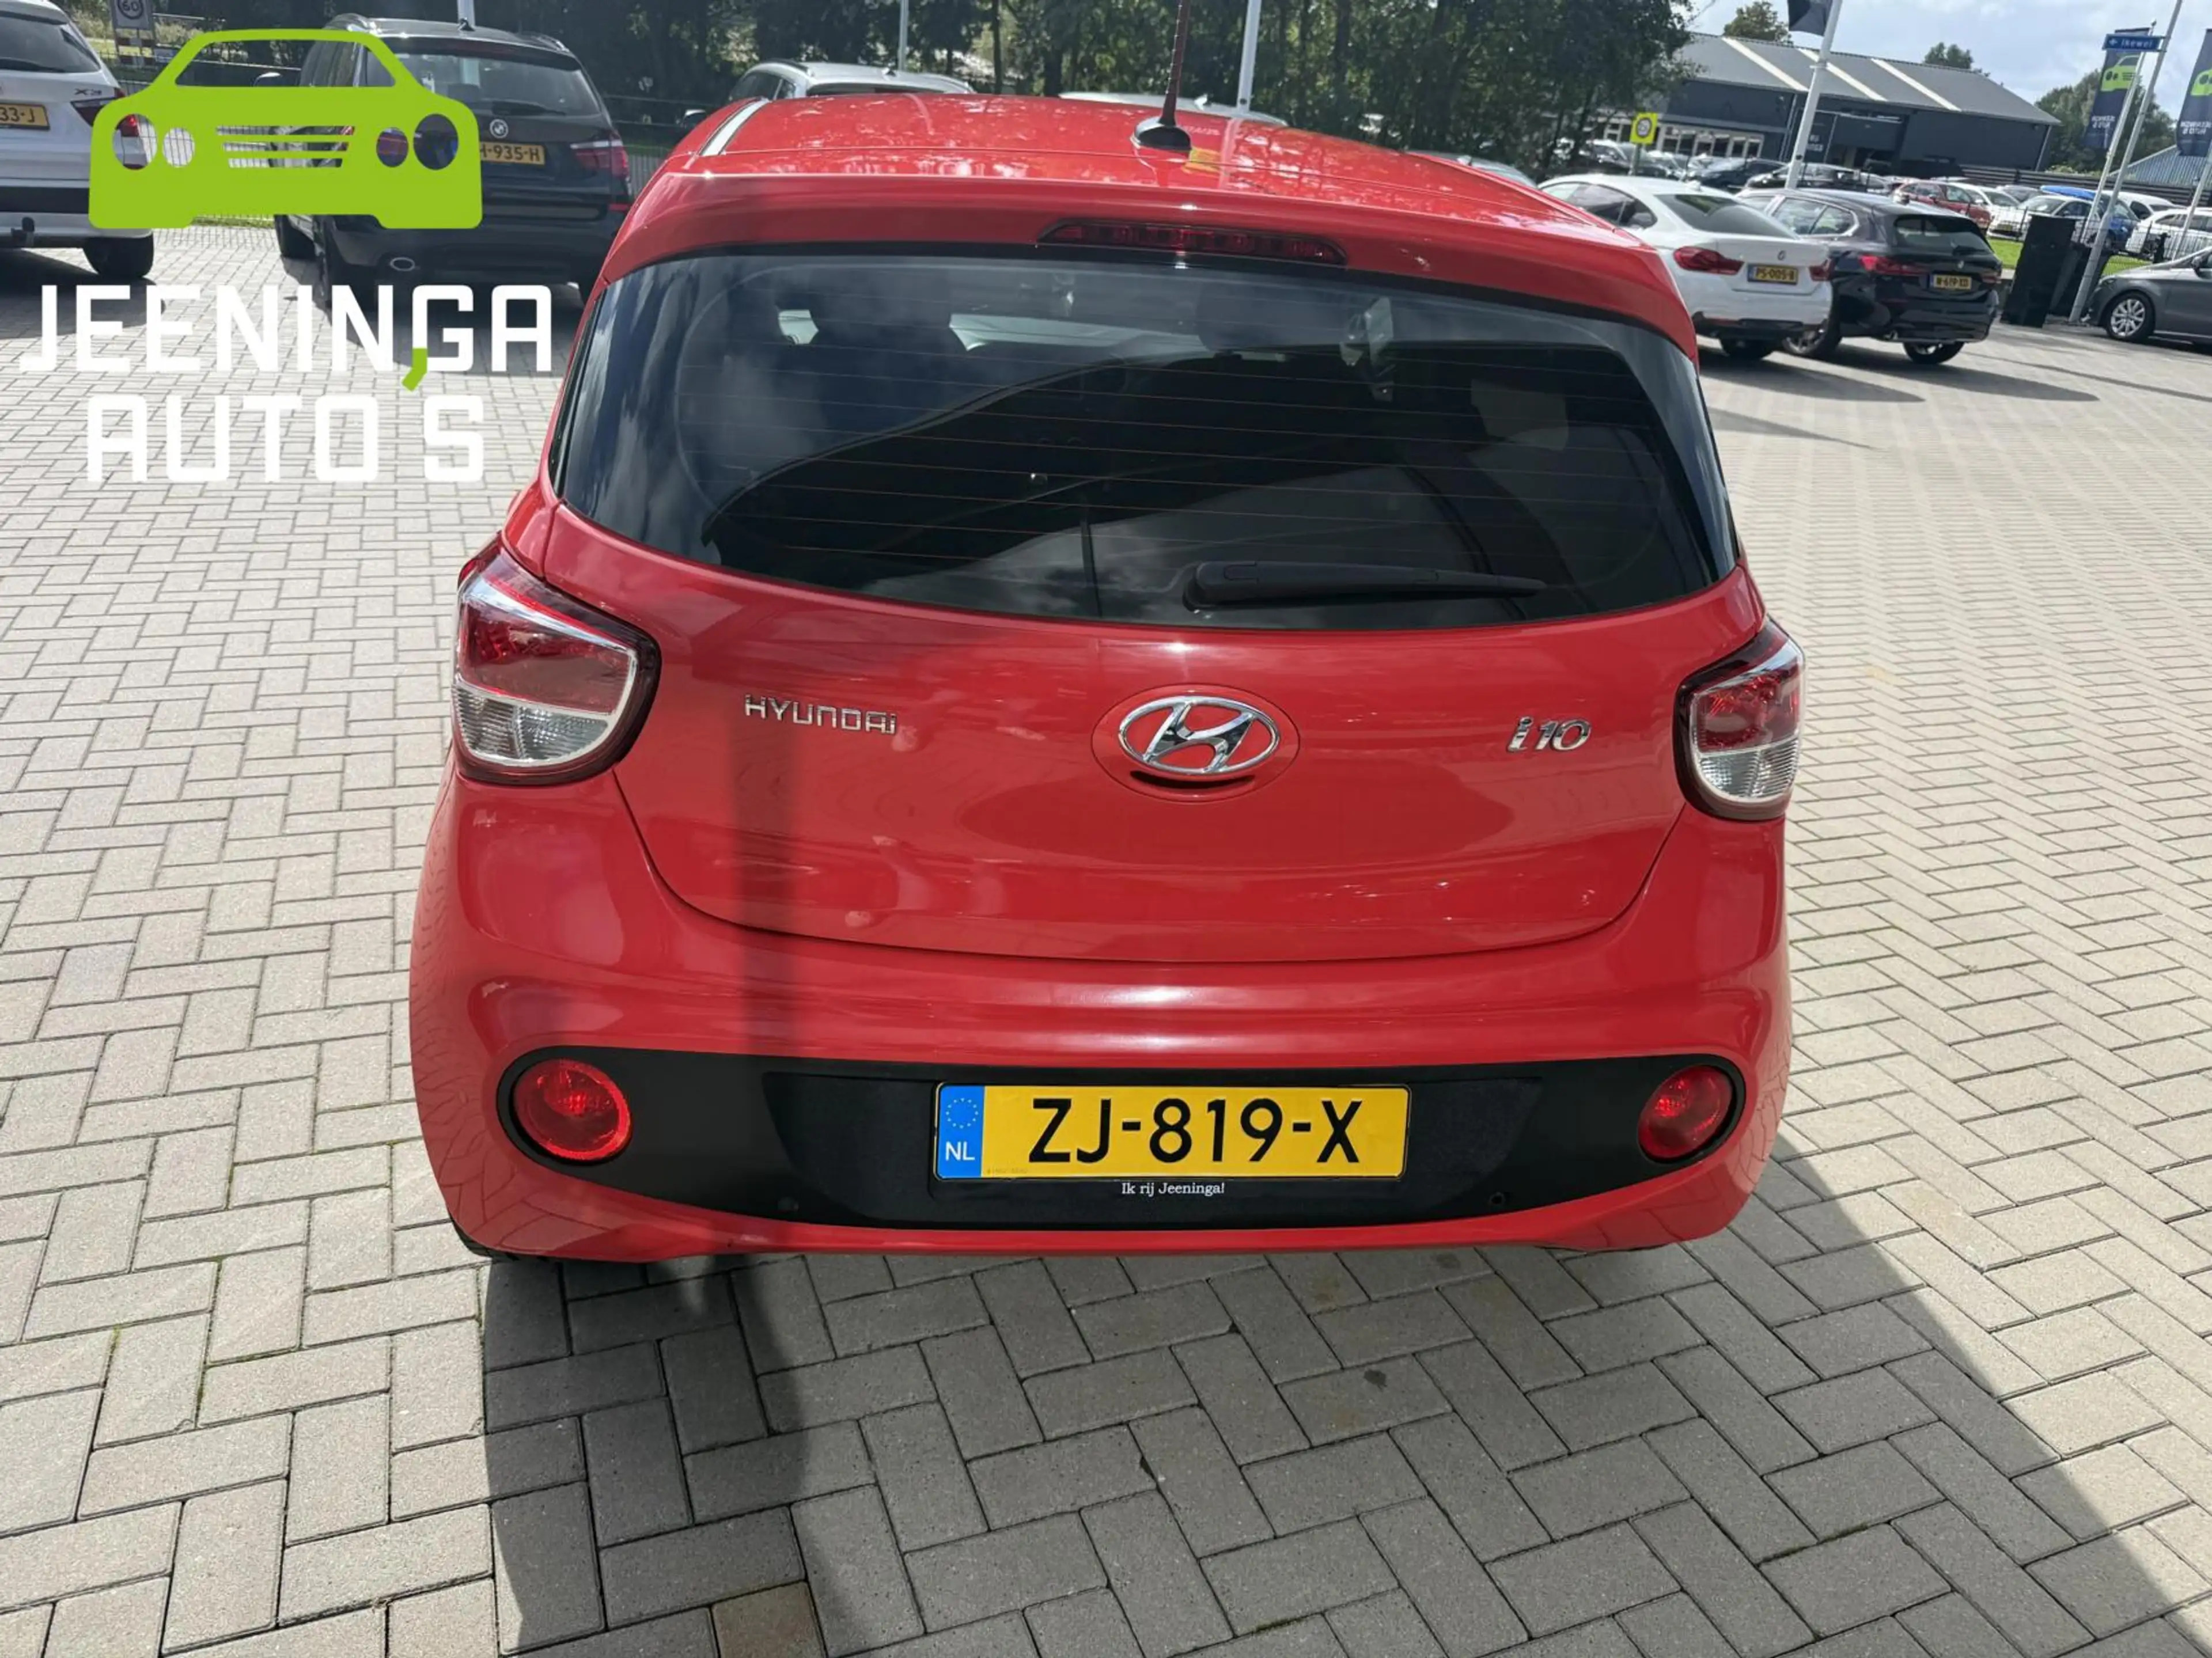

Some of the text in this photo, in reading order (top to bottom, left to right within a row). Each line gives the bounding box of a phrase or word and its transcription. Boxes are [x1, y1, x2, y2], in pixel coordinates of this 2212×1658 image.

[745, 694, 896, 734] HYUNDAI
[1506, 716, 1592, 752] i10
[945, 1098, 1362, 1163] NL ZJ-819-X
[1122, 1182, 1225, 1197] Ik rij Jeeninga!
